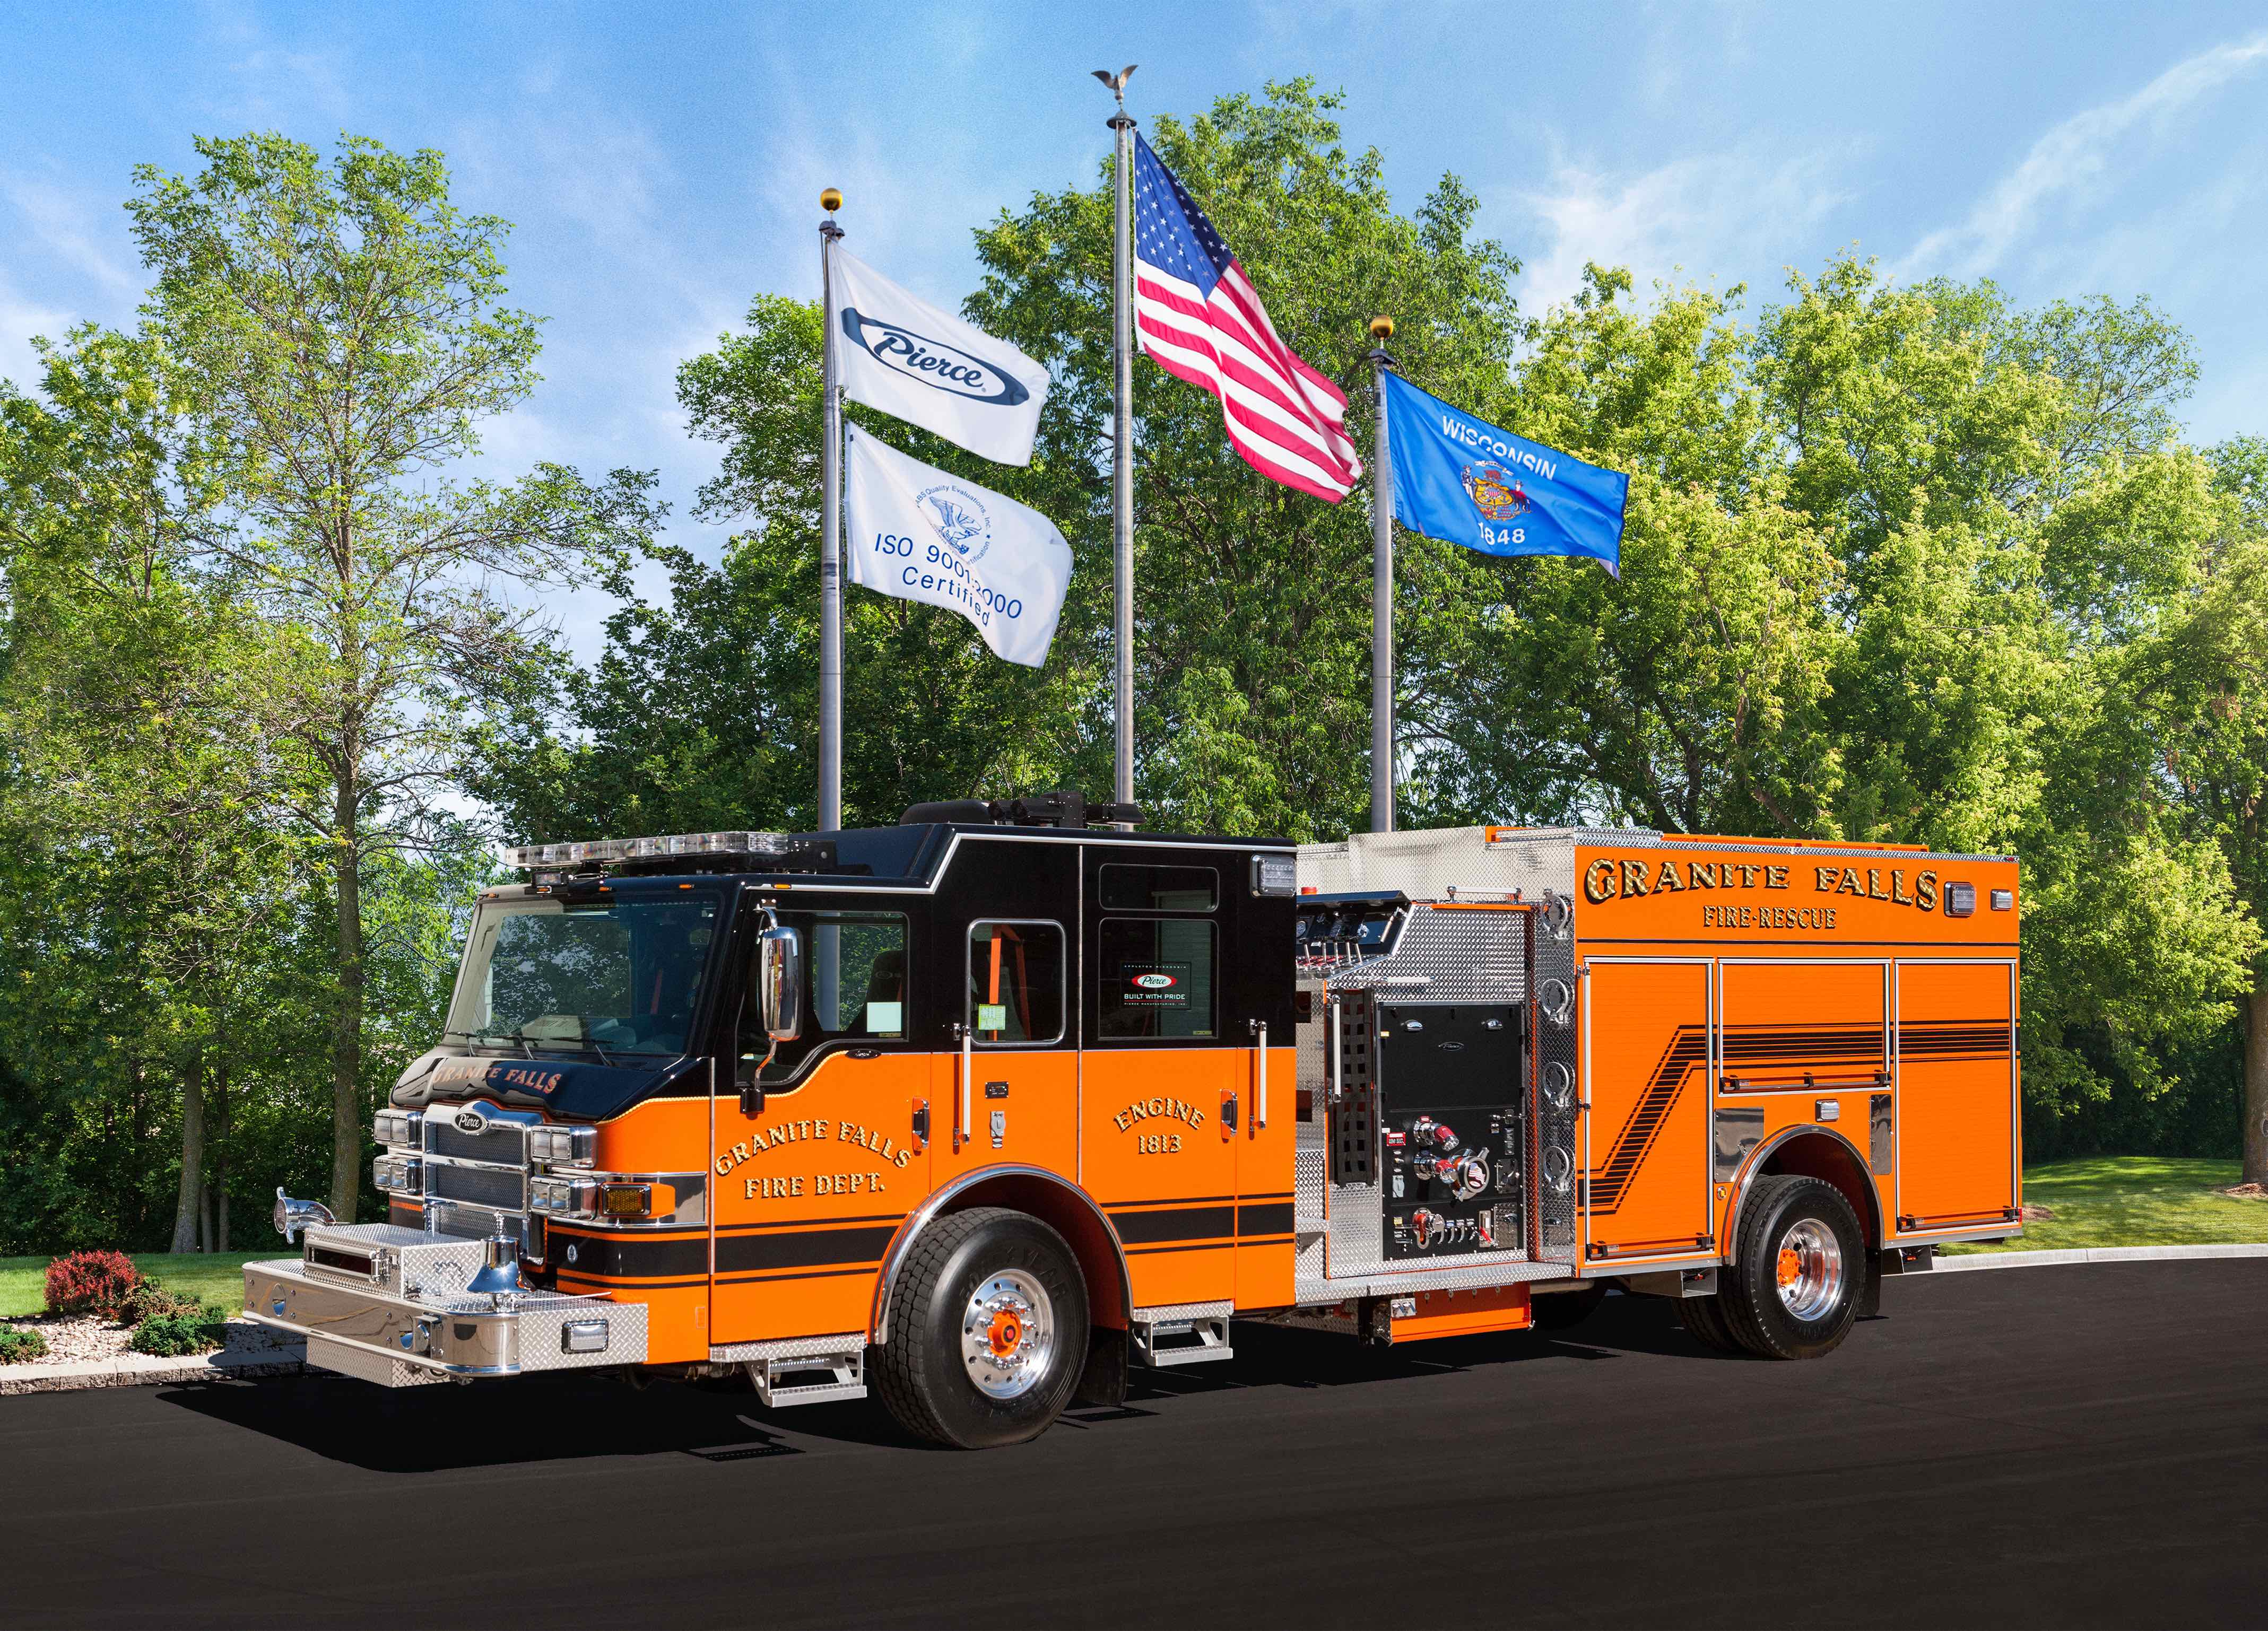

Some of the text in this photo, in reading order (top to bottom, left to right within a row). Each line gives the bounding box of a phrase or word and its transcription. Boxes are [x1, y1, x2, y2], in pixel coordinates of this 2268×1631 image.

[874, 332, 984, 387] Pierce
[1443, 415, 1557, 481] WISCONSIN
[875, 533, 913, 557] ISO
[1478, 522, 1525, 545] 1848
[902, 566, 990, 627] Certified
[1584, 859, 1938, 912] GRANITE FALLS
[1142, 976, 1167, 985] Pierce
[505, 1069, 561, 1094] FALLS
[459, 1114, 480, 1128] Pierce
[1114, 1097, 1205, 1133] ENGINE
[715, 1120, 911, 1176] GRANITE FALLS
[1138, 1134, 1181, 1154] 1813
[744, 1172, 885, 1199] FIRE DEPT.
